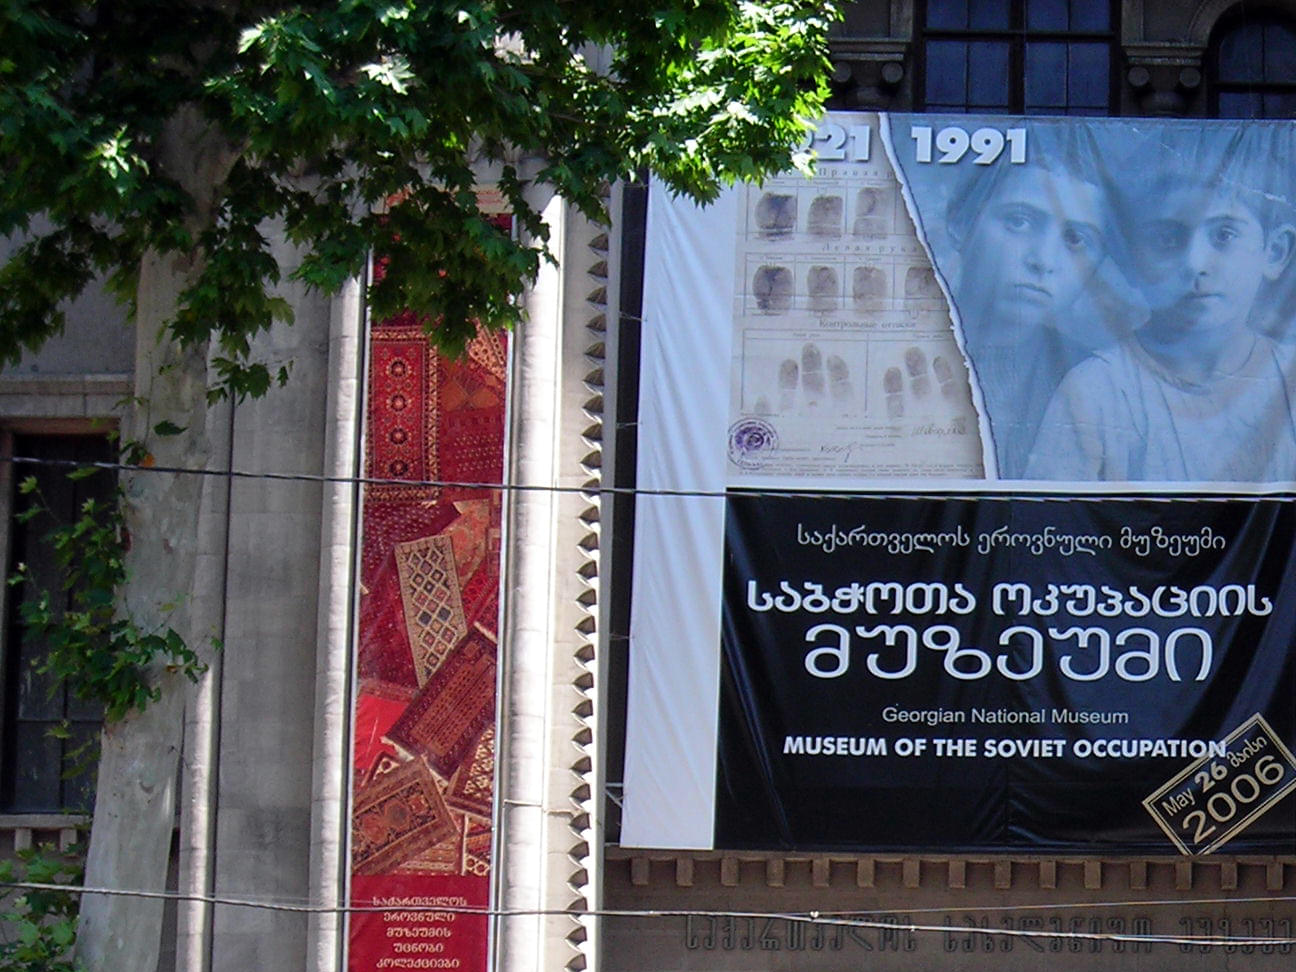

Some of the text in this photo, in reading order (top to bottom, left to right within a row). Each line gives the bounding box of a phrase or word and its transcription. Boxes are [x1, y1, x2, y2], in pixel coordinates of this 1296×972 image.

[911, 126, 1027, 165] 1991
[797, 523, 1226, 557] საქართველოს ეროვნული მუზეუმი
[747, 580, 1273, 617] საბჭოთა ოკუპაციის
[804, 623, 1213, 682] მუზეუმი
[882, 706, 1129, 726] Georgian National Museum
[783, 736, 1227, 760] MUSEUM OF THE SOVIET OCCUPATION
[1162, 788, 1196, 817] May
[1195, 761, 1228, 793] 26
[1182, 755, 1285, 844] 2006
[372, 896, 468, 907] საქართველოს
[384, 912, 455, 922] ეროვნული
[387, 927, 451, 937] მუზეუმის
[393, 943, 444, 953] უცნობი
[376, 958, 459, 968] კოლექციები
